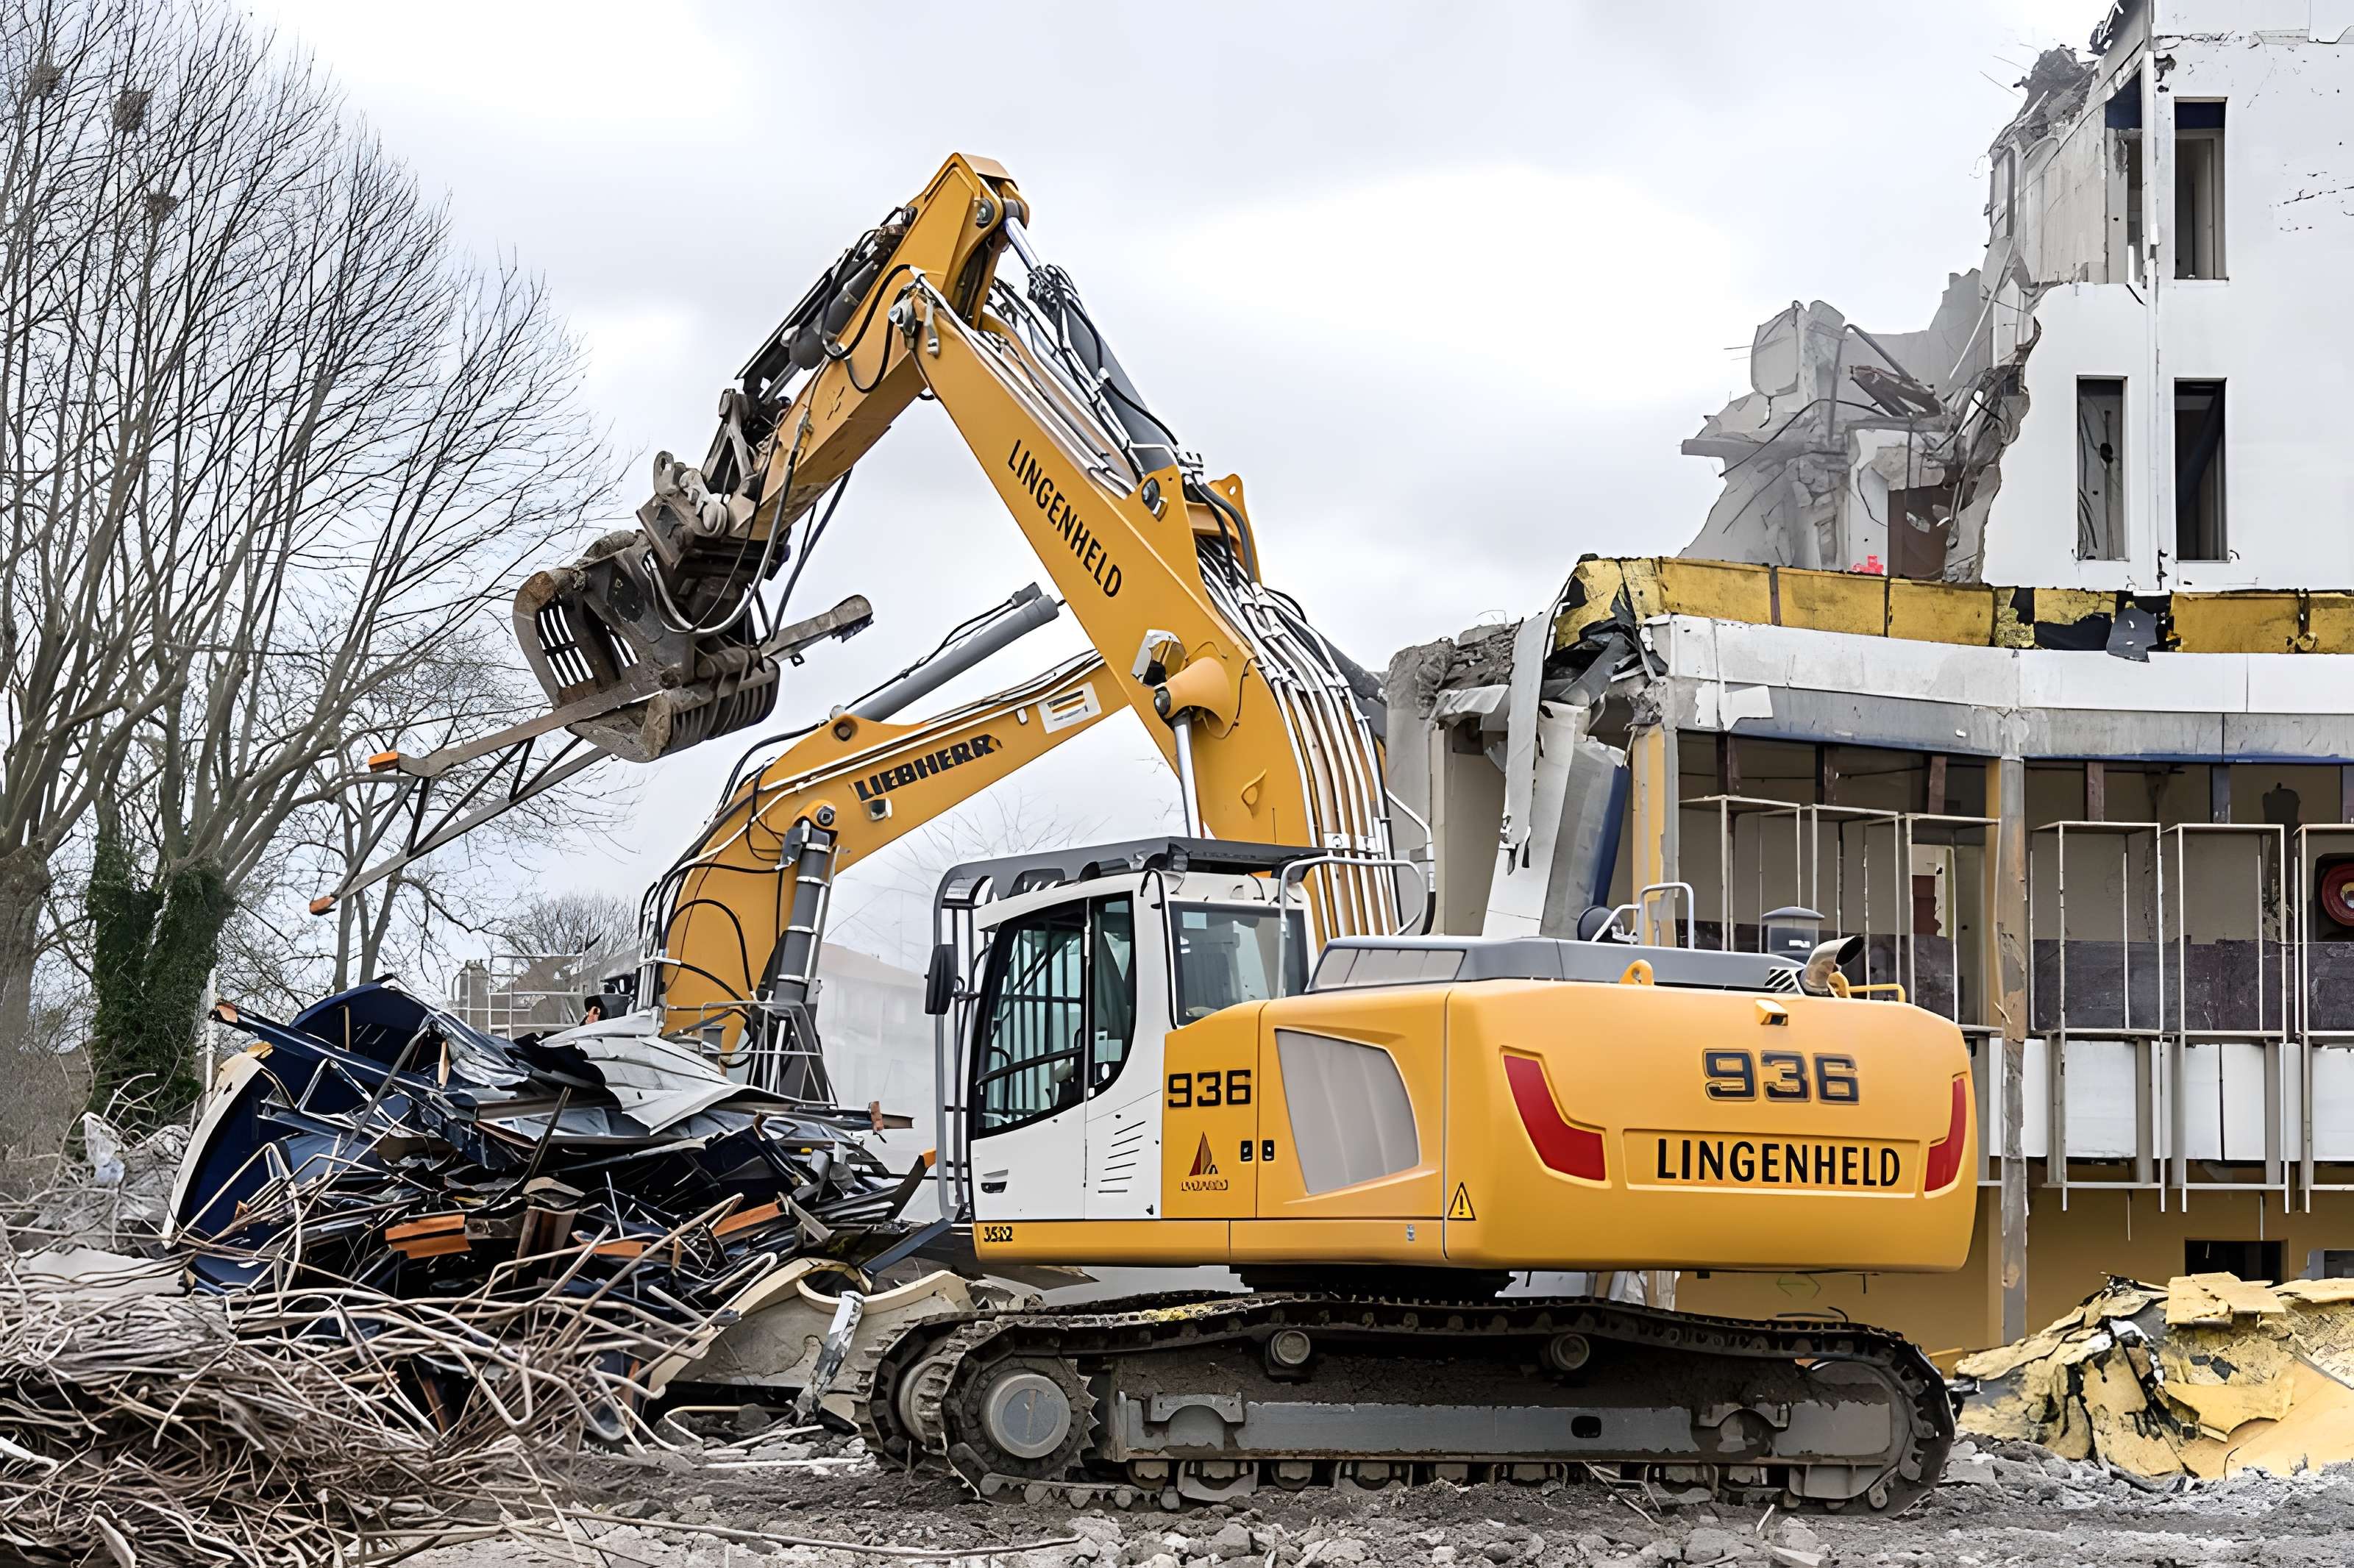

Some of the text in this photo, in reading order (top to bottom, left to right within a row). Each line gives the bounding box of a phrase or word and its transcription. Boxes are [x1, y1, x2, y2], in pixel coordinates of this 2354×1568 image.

[1008, 440, 1122, 597] LINGENHELD
[853, 734, 996, 801] LIEBHERR
[1168, 1069, 1251, 1108] 936
[1702, 1049, 1860, 1105] 936
[1657, 1138, 1901, 1186] LINGENHELD
